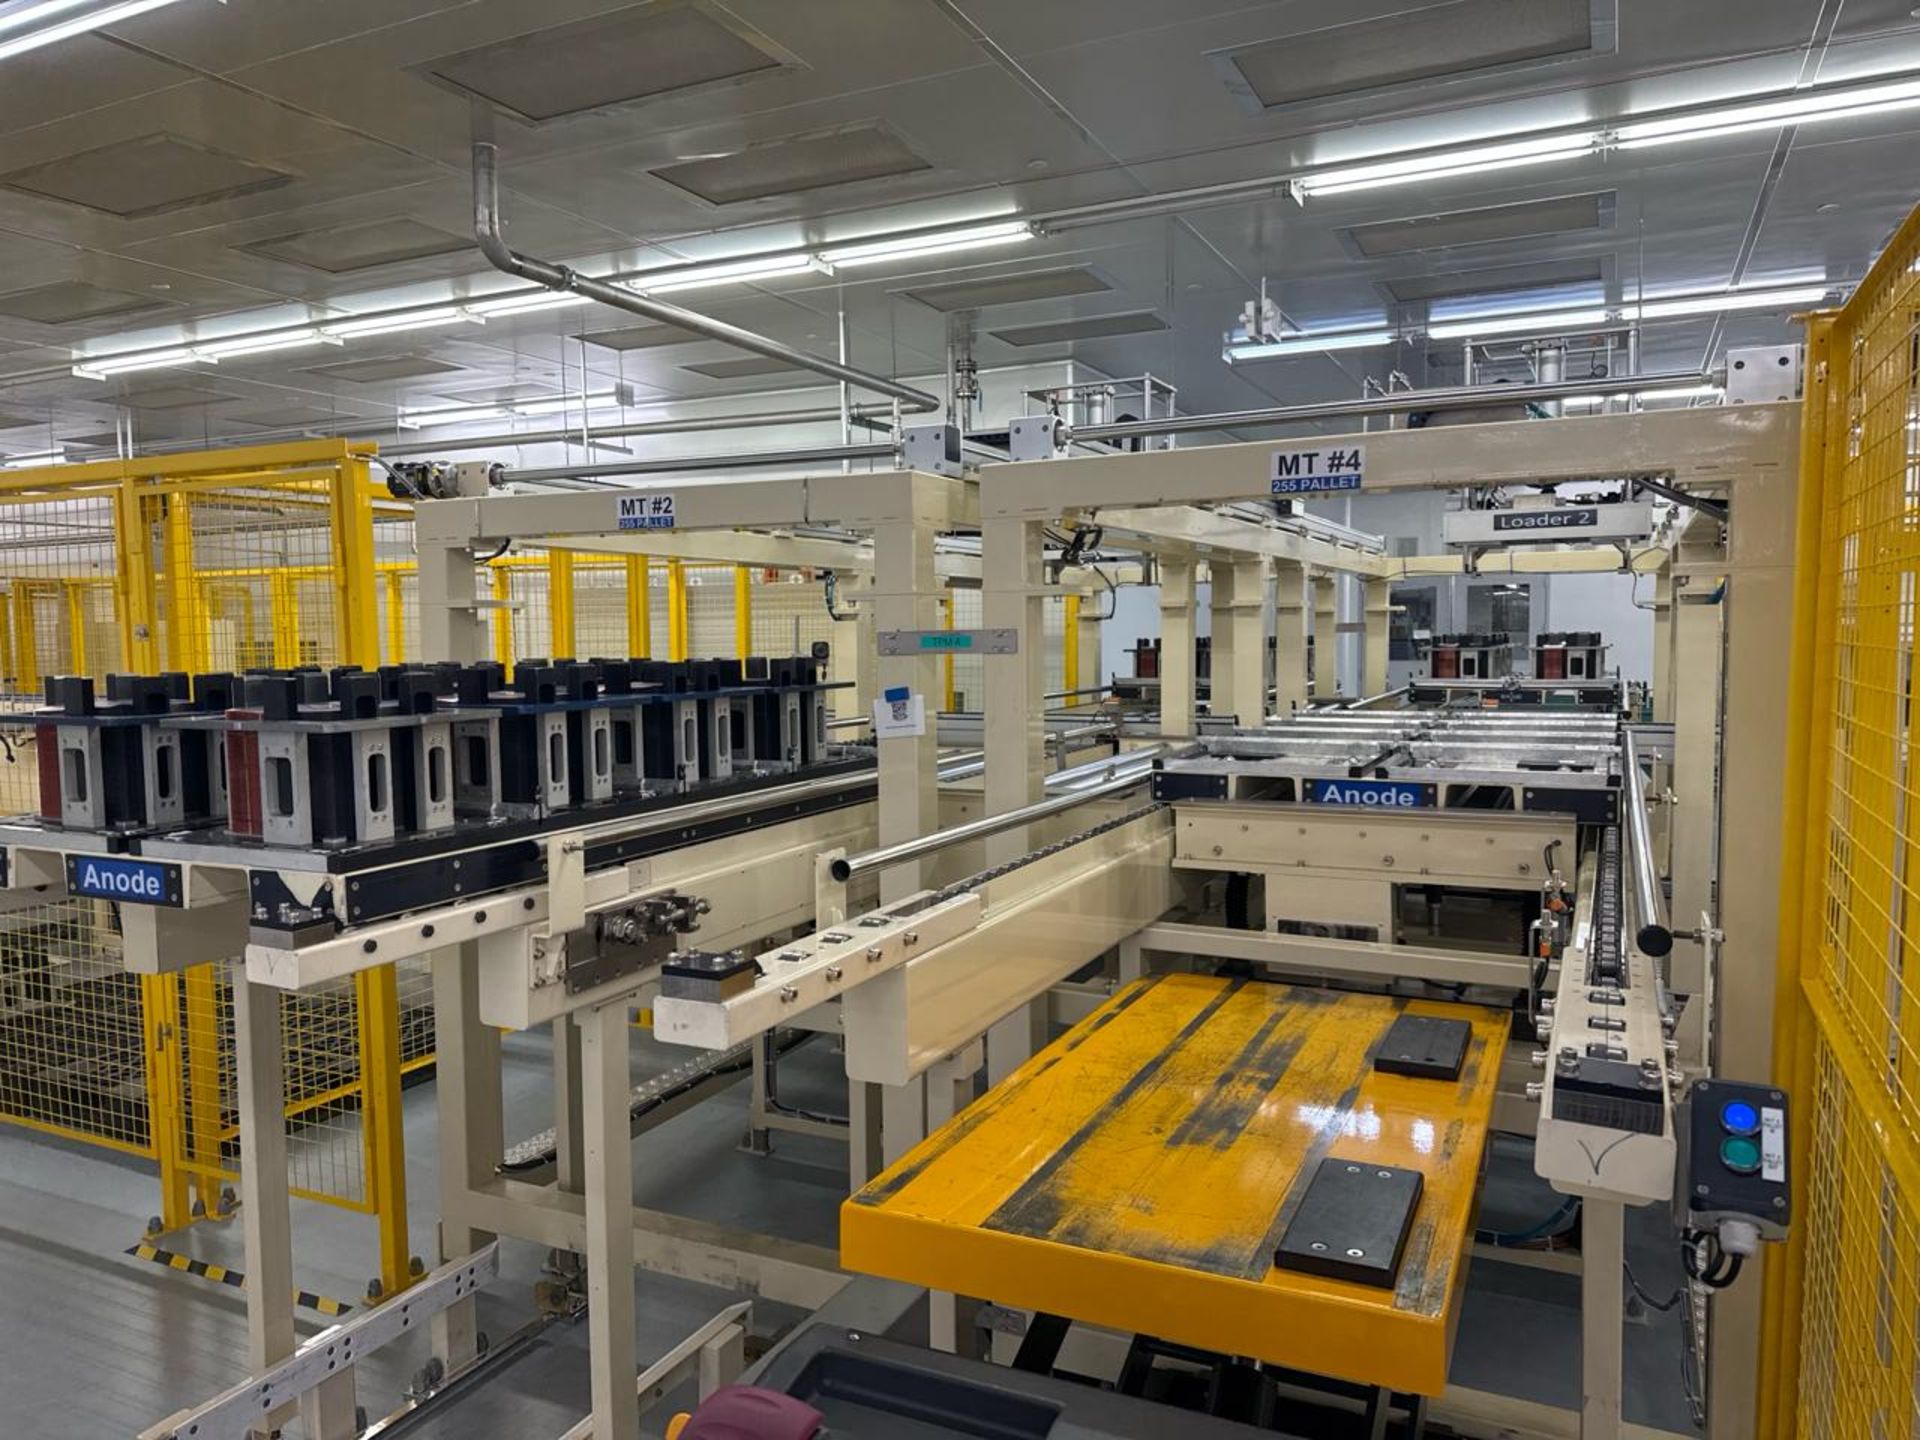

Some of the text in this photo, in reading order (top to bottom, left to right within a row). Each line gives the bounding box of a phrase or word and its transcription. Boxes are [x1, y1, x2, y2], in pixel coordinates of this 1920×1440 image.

[1278, 449, 1361, 476] MT #4
[1273, 476, 1359, 493] 255 PALLET
[621, 496, 672, 516] MT #2
[636, 517, 672, 528] PALLET
[1501, 512, 1590, 528] Loader 2
[1322, 784, 1414, 806] Anode
[83, 864, 160, 896] Anode
